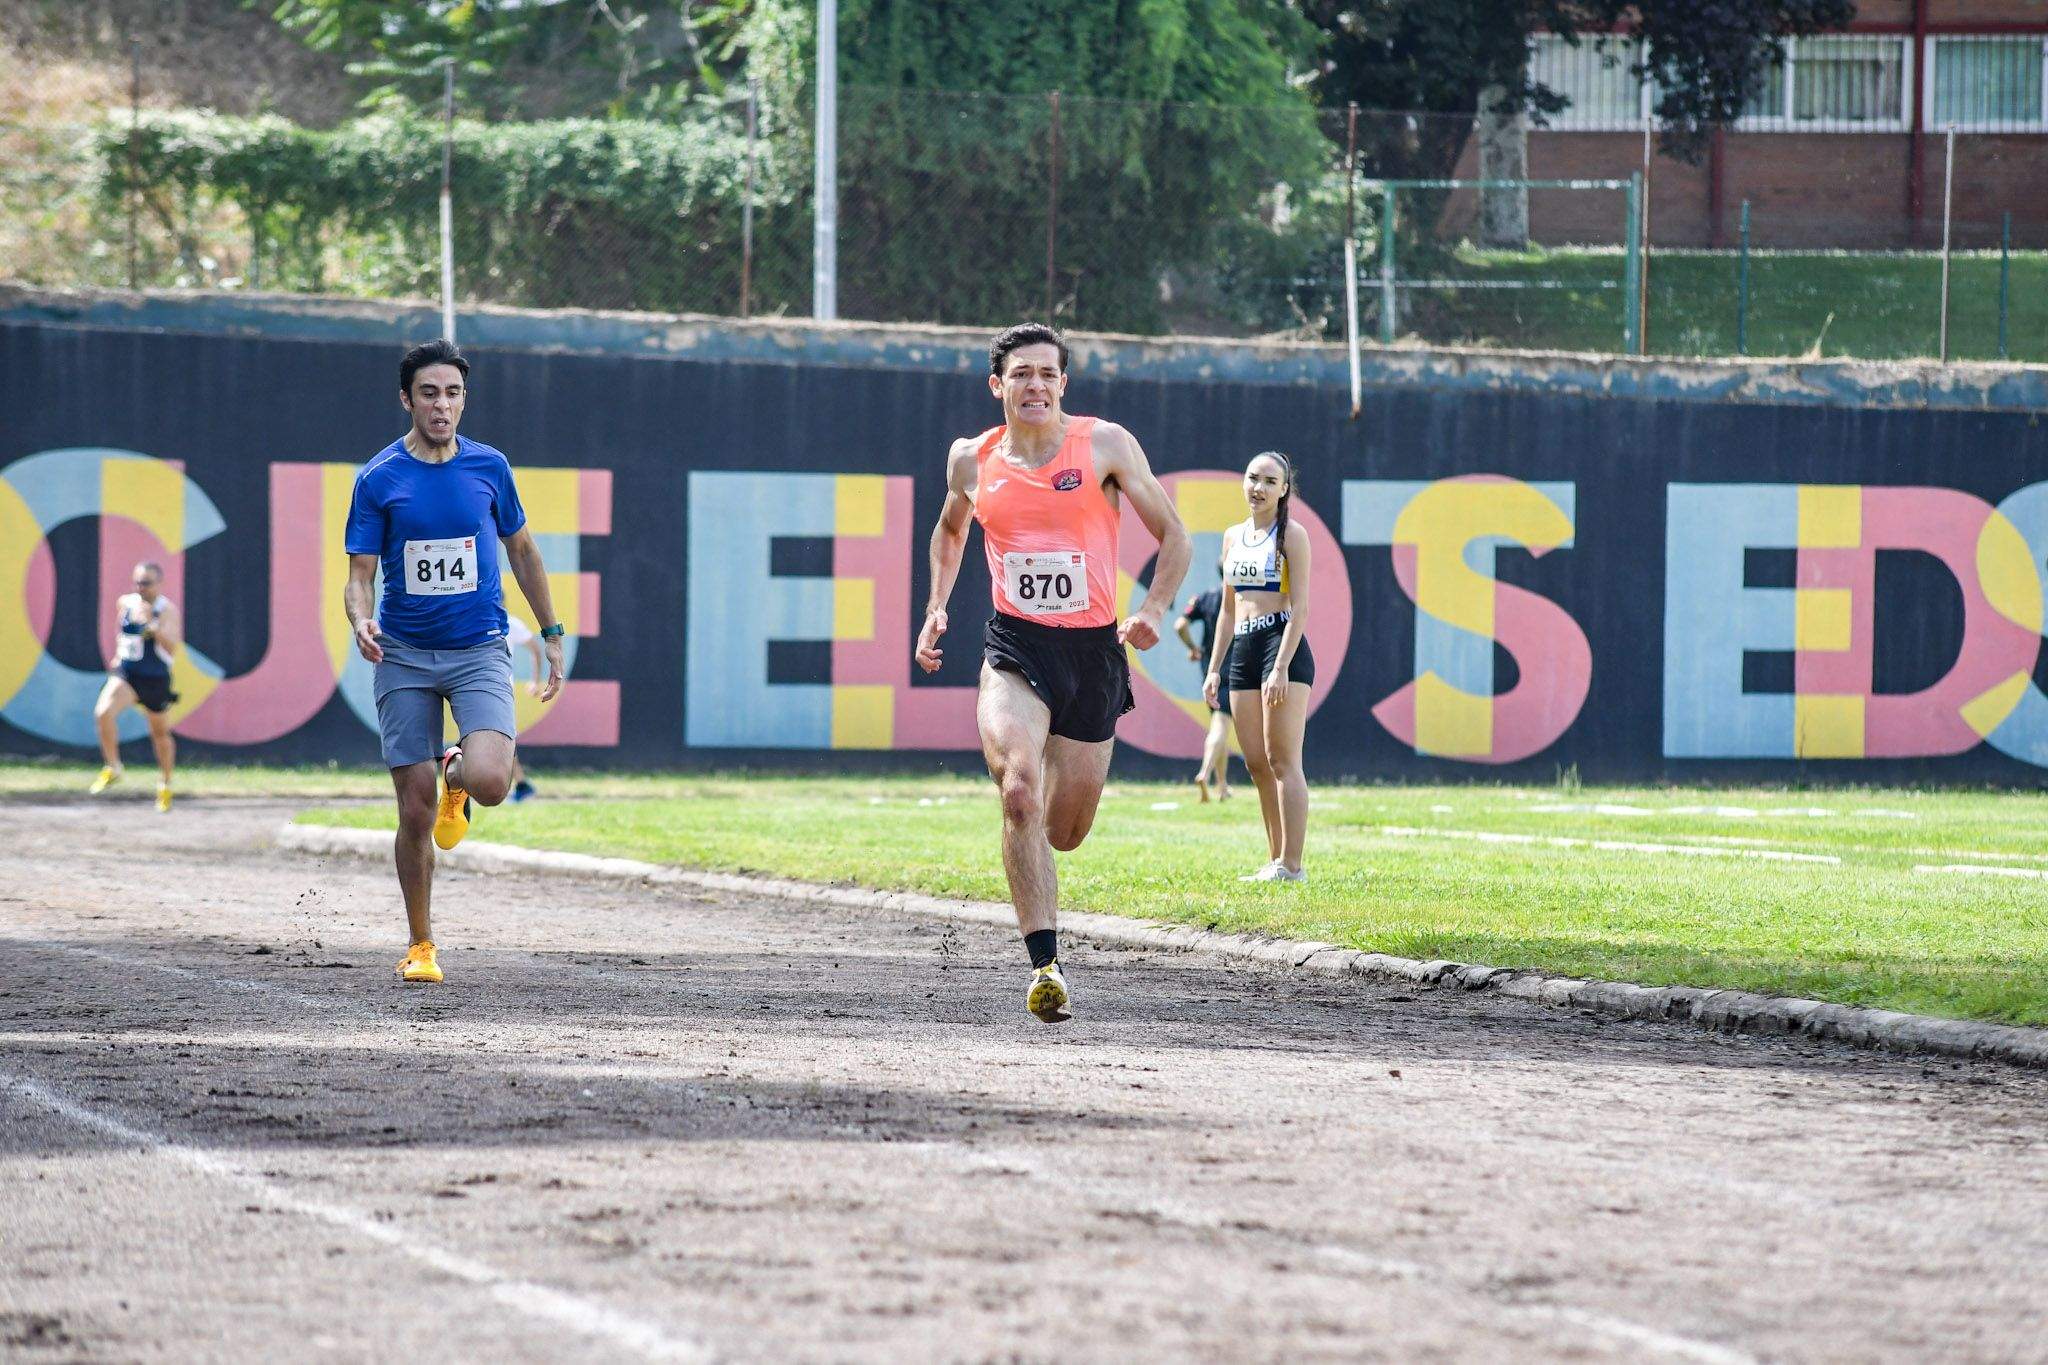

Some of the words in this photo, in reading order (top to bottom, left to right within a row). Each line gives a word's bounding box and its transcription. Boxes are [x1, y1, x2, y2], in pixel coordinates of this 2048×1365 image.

[417, 557, 465, 582] 814
[1232, 561, 1257, 577] 756
[1019, 574, 1072, 600] 870
[1068, 600, 1085, 608] 2023
[1249, 613, 1275, 633] PRO
